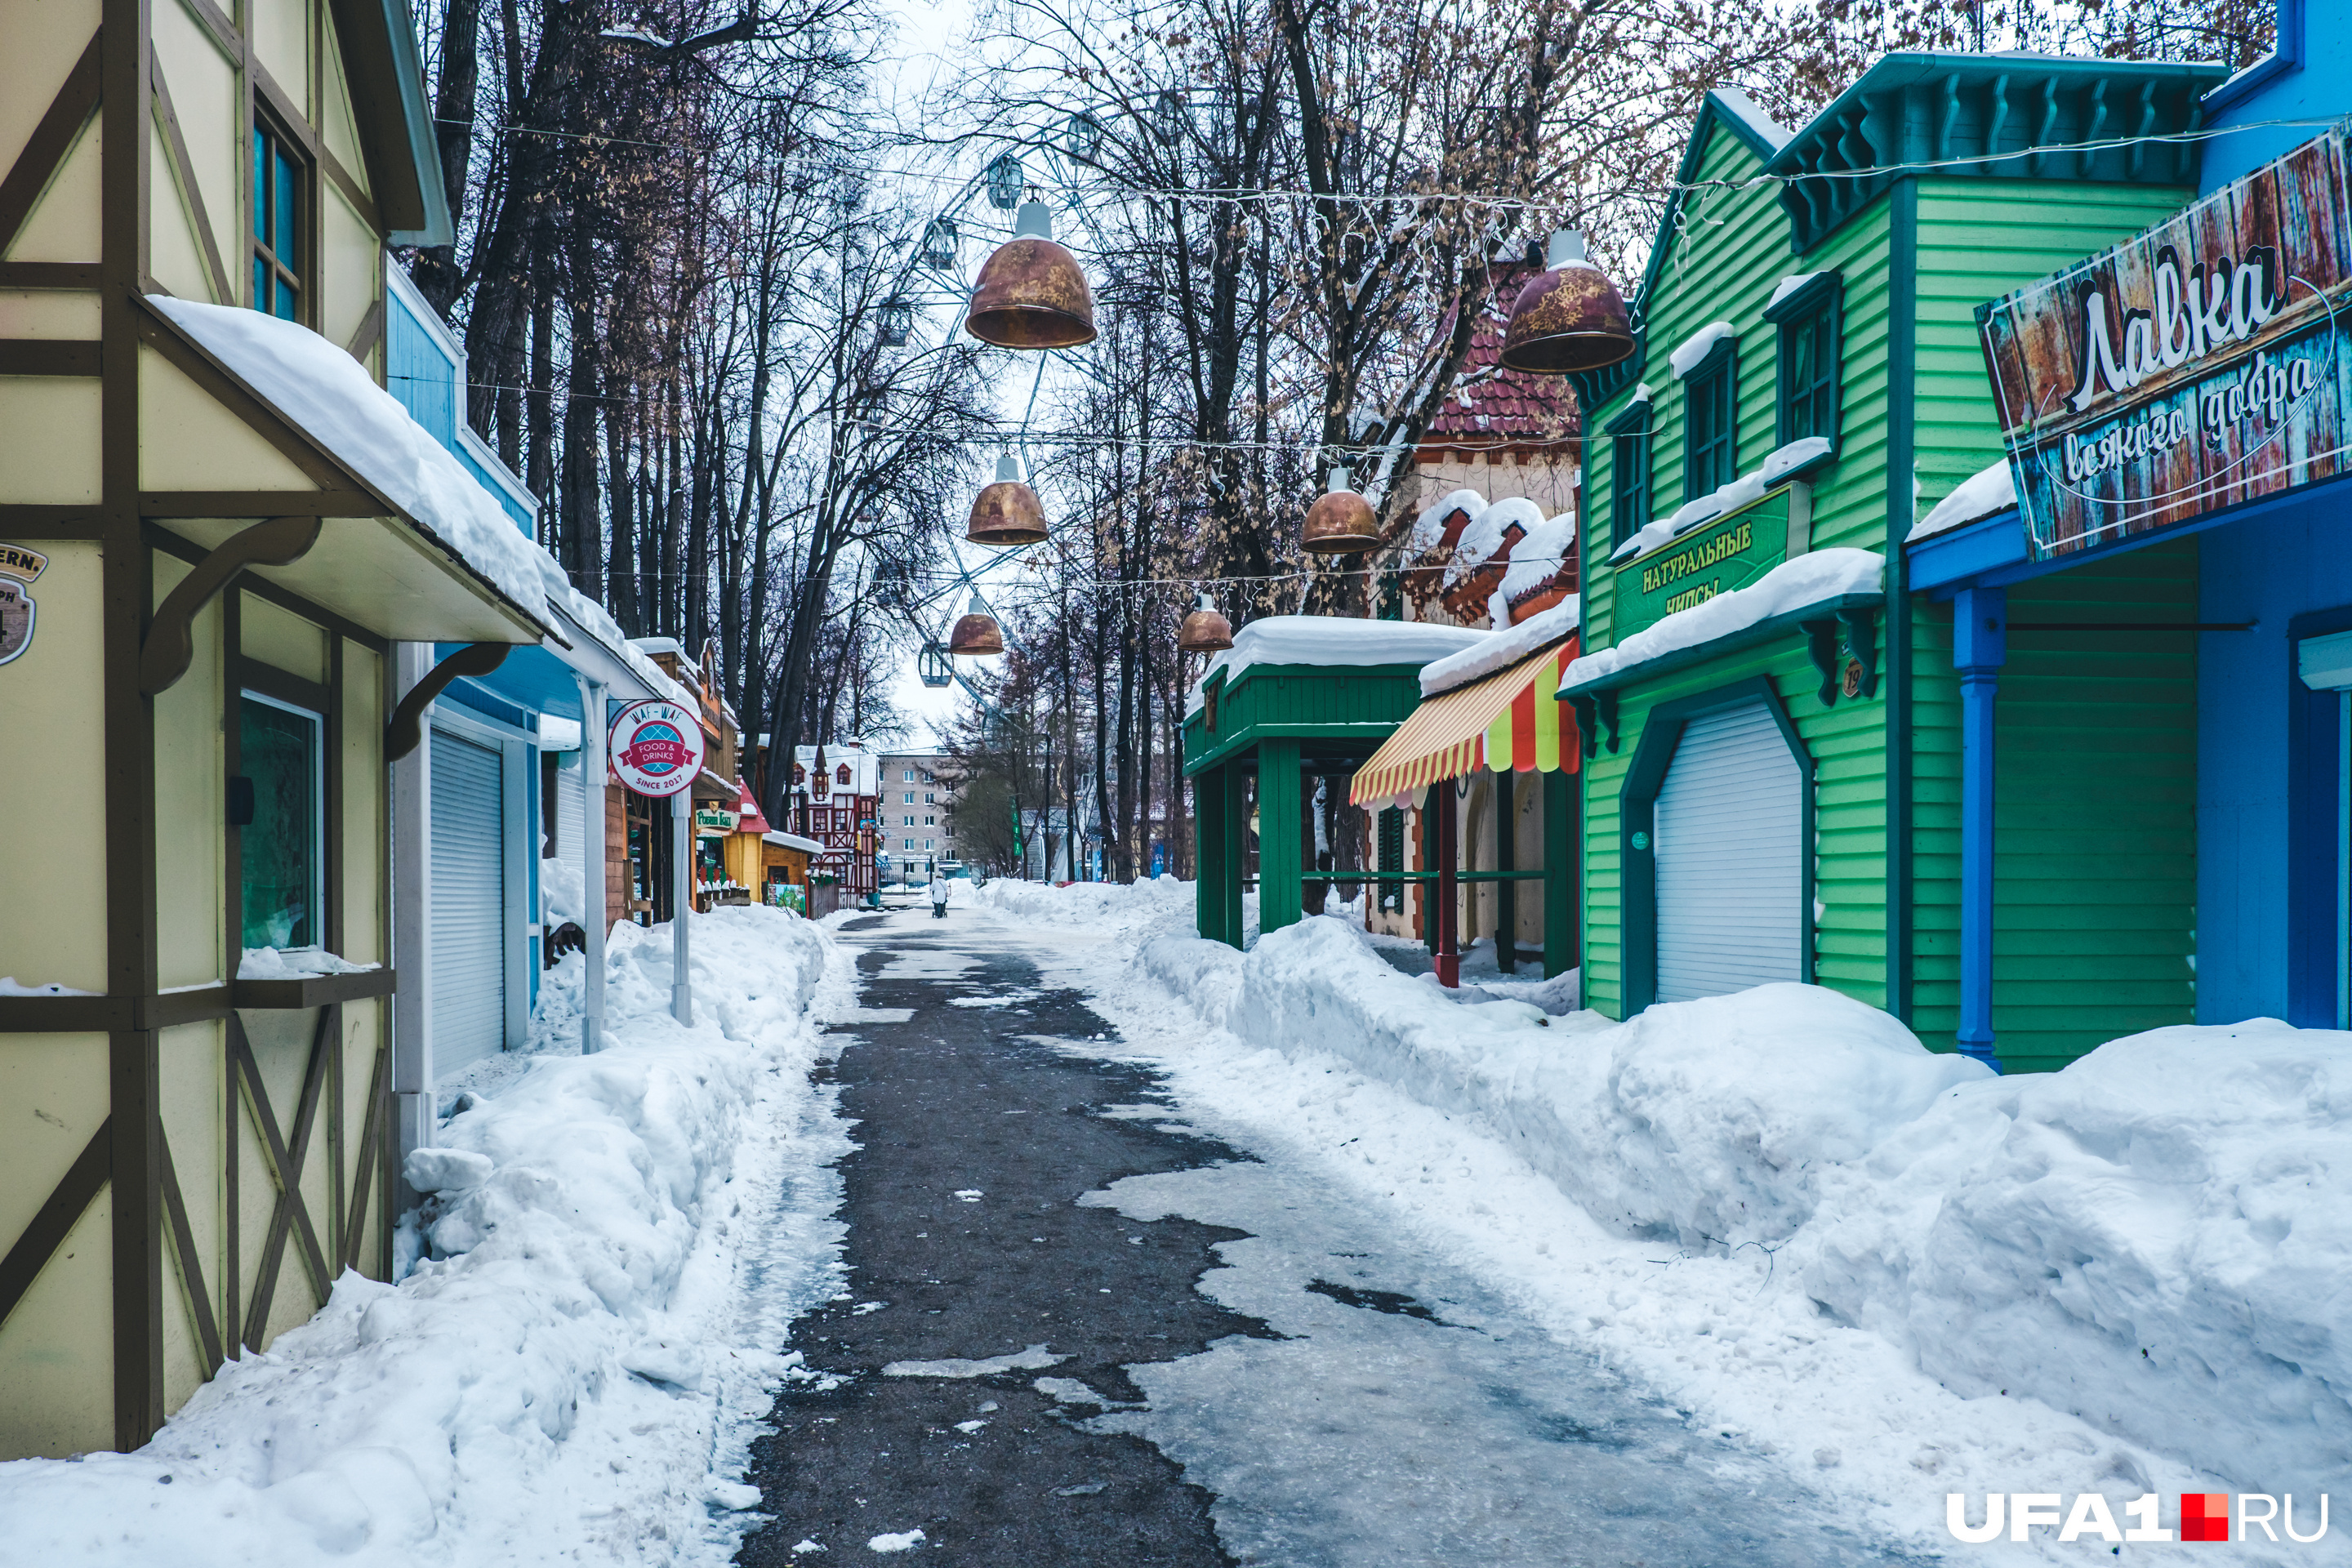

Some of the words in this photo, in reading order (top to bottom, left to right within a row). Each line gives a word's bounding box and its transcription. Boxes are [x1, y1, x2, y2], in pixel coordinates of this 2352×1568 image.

[2062, 245, 2290, 414] Лавка
[2060, 408, 2189, 486] всякого
[2202, 350, 2318, 448] добра
[1642, 523, 1753, 595] НАТУРАЛЬНЫЕ
[1666, 577, 1720, 615] ЧИПСЫ
[1847, 669, 1860, 690] 19
[639, 742, 666, 753] FOOD
[668, 743, 675, 751] &
[642, 751, 674, 762] DRINKS
[635, 777, 661, 790] SINCE
[664, 774, 683, 788] 2017
